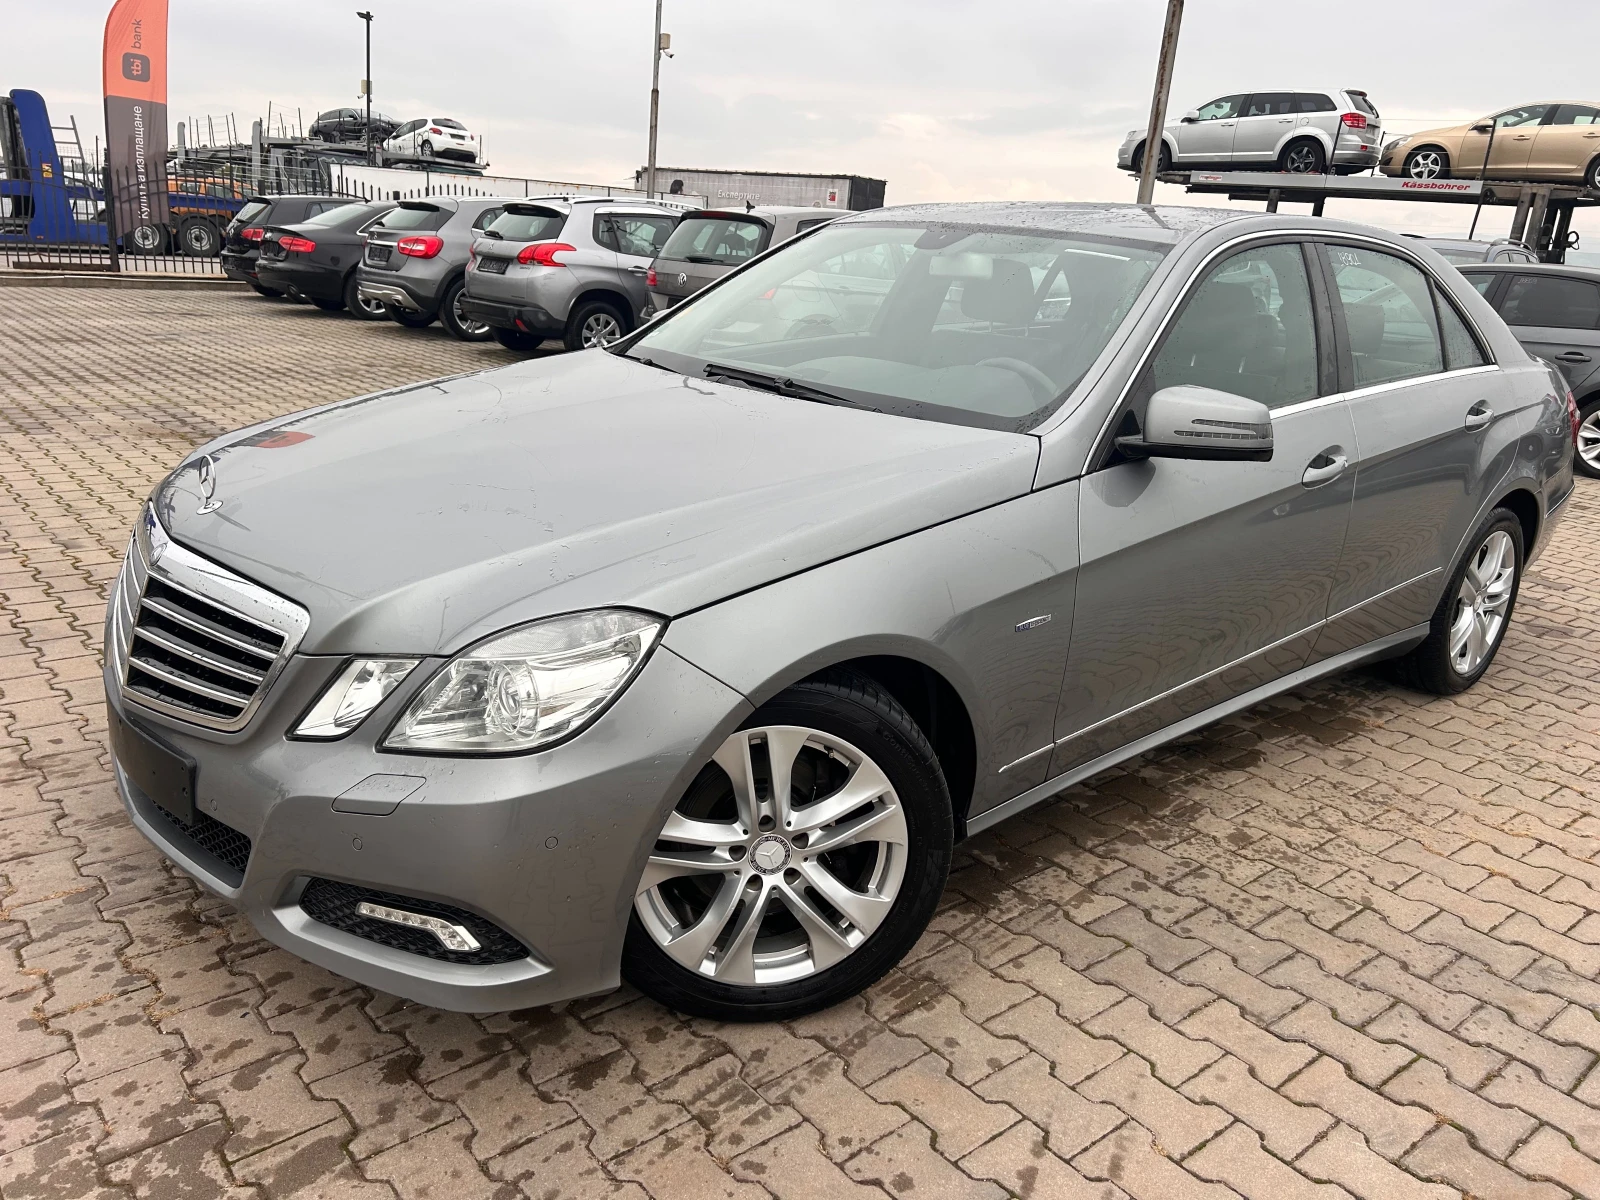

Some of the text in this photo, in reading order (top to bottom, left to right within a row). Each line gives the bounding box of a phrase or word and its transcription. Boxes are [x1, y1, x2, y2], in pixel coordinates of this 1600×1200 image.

[130, 19, 142, 76] tbi bank
[133, 105, 145, 172] изплащане
[717, 189, 760, 201] Експертите
[1401, 181, 1471, 191] Kässbohrer
